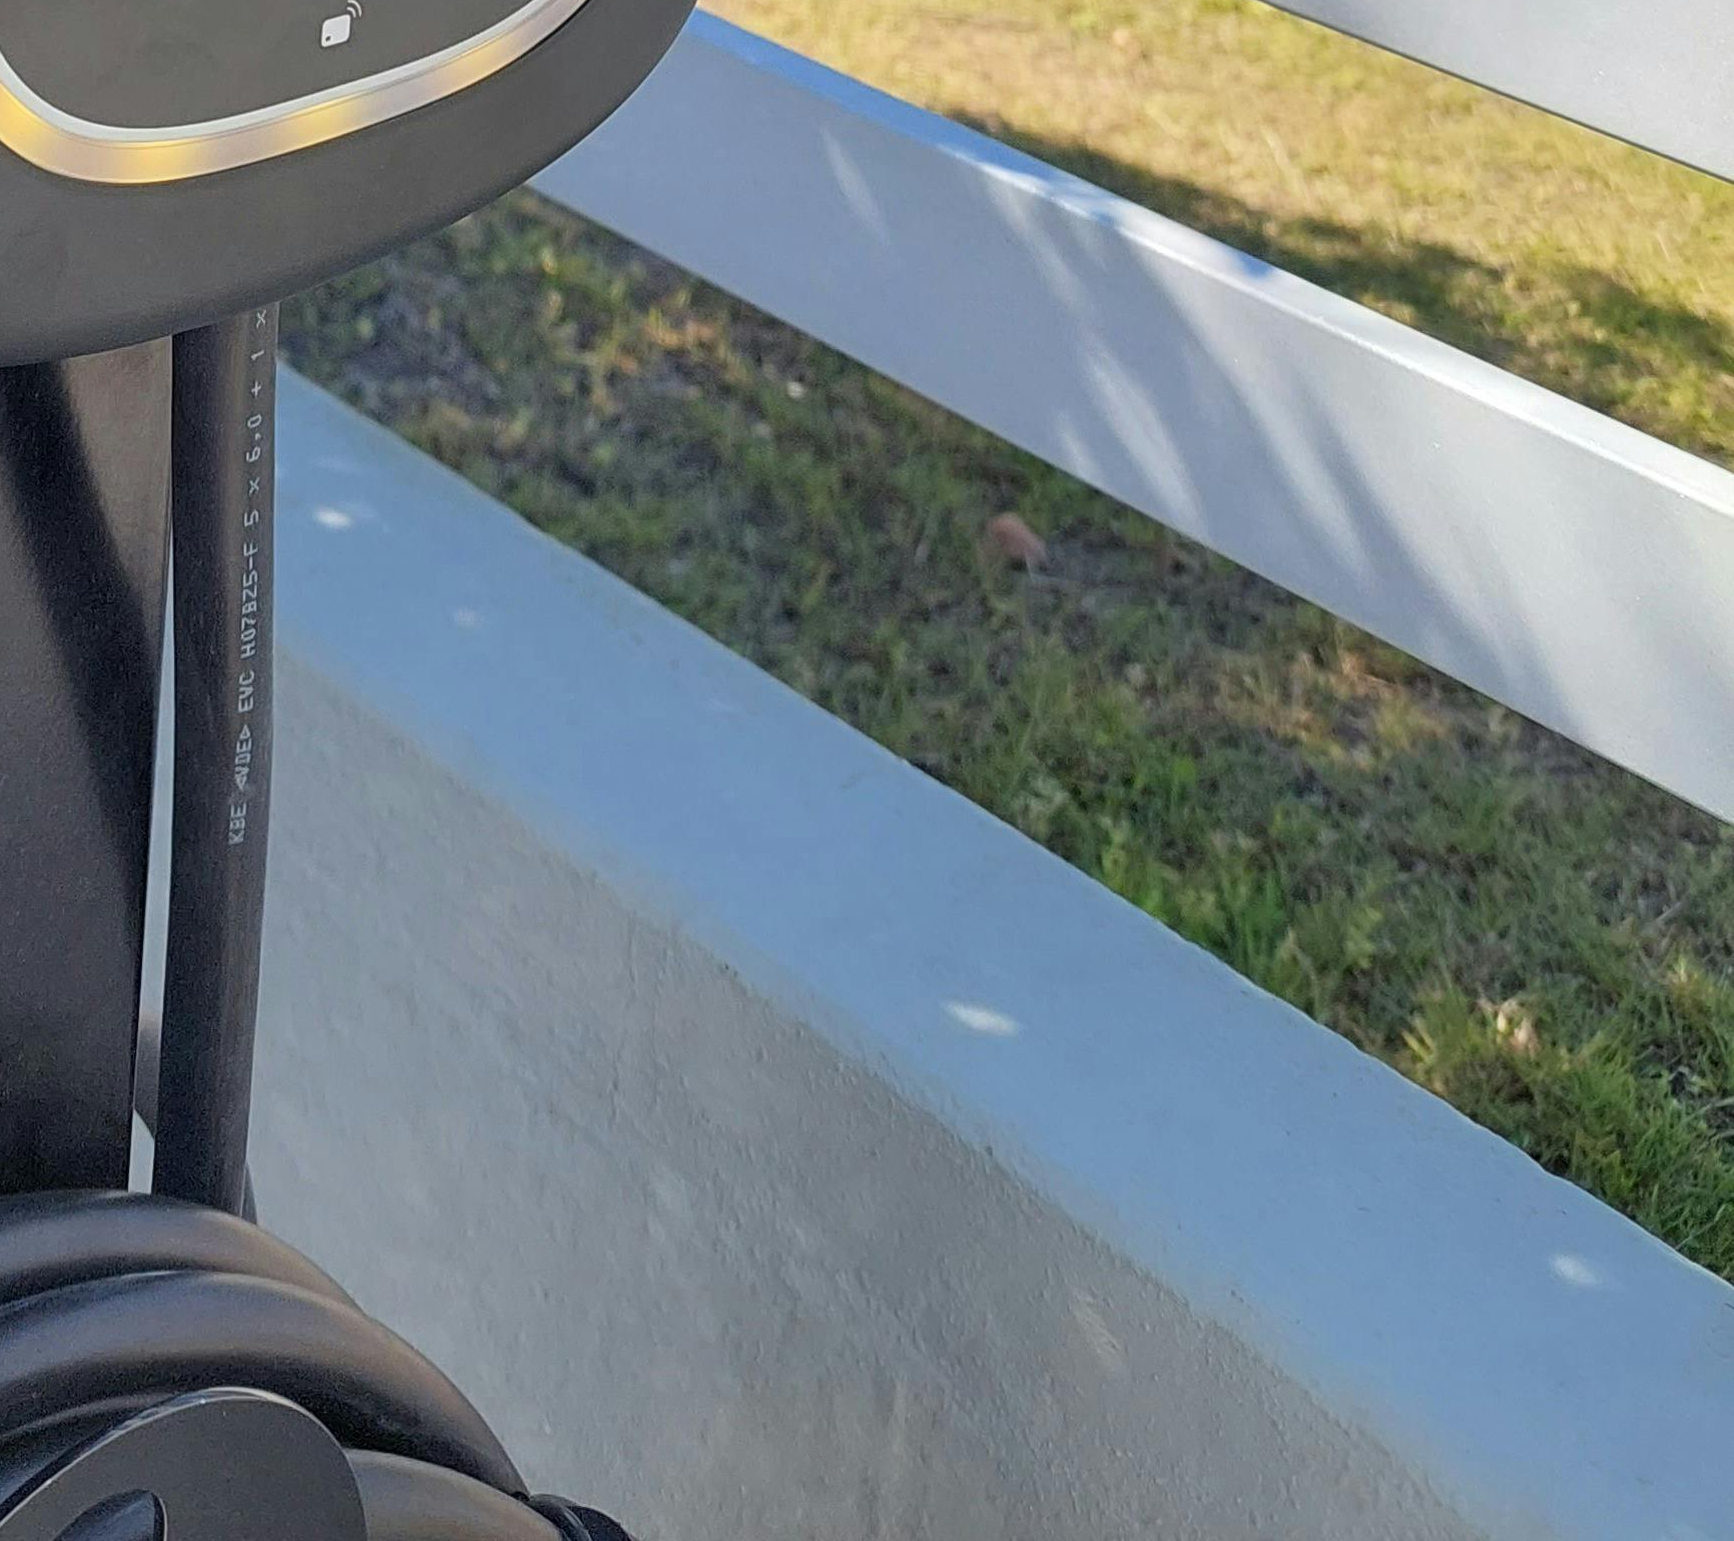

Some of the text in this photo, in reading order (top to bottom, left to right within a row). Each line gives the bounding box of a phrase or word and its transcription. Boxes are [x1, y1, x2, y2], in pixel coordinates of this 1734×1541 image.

[250, 349, 265, 362] 1
[243, 509, 260, 528] 5
[240, 539, 259, 659] H07BZ5-F
[238, 670, 255, 714] EVC
[228, 802, 247, 847] KBE
